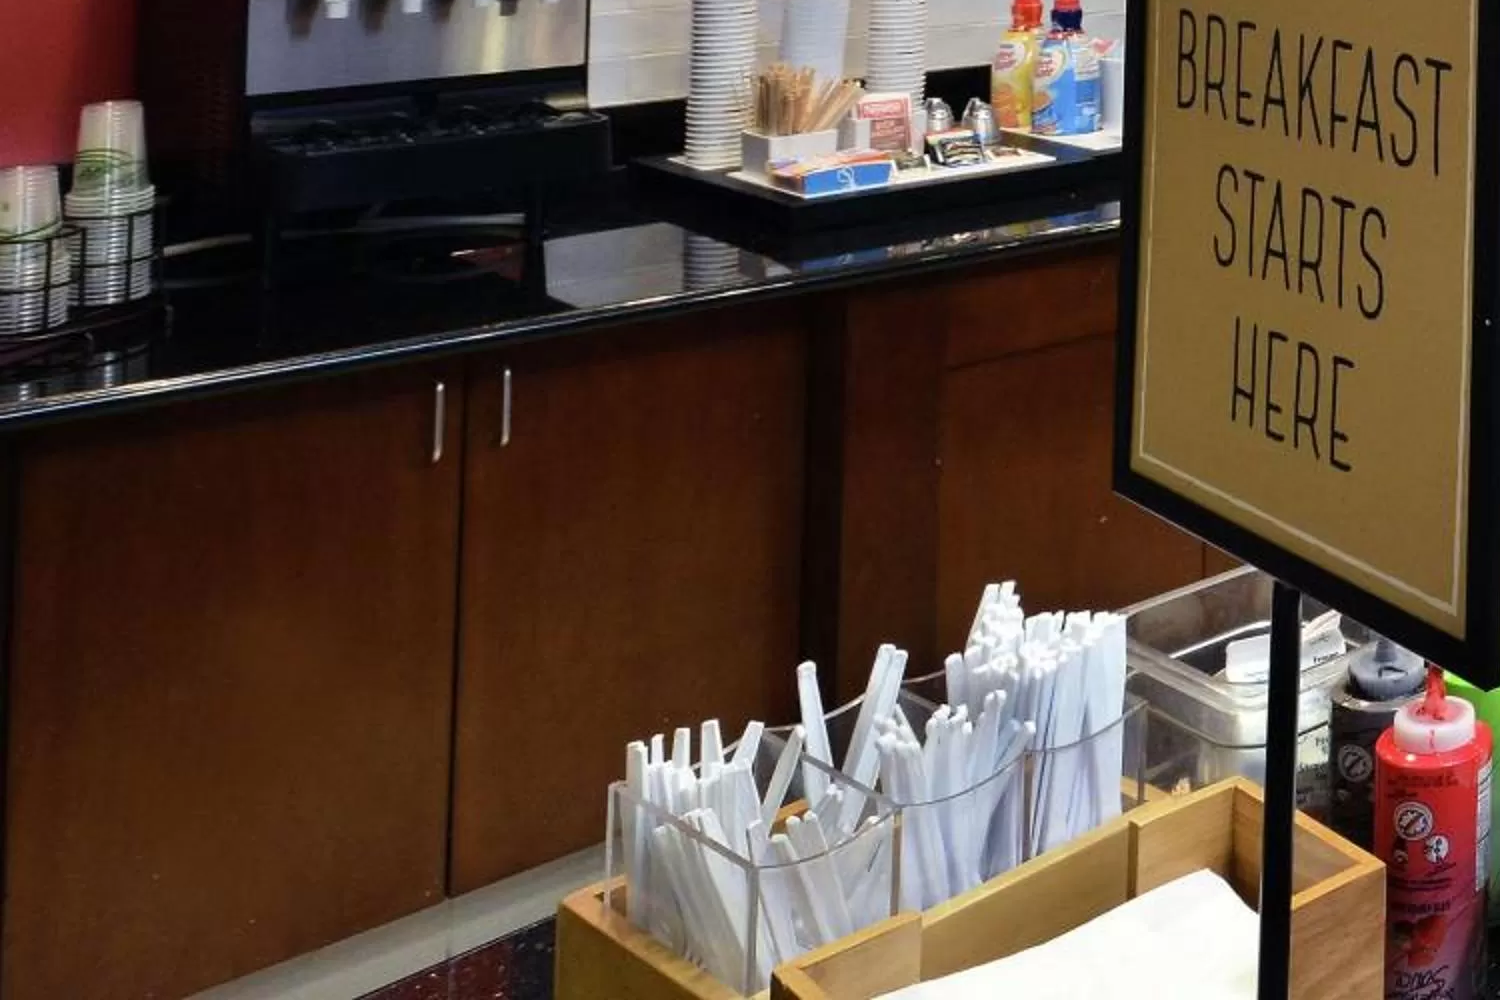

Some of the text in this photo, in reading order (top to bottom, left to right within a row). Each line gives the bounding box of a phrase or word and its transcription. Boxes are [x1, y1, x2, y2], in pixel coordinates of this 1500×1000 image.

[1175, 7, 1453, 177] BREAKFAST
[1213, 163, 1387, 320] STARTS
[1231, 315, 1355, 472] HERE
